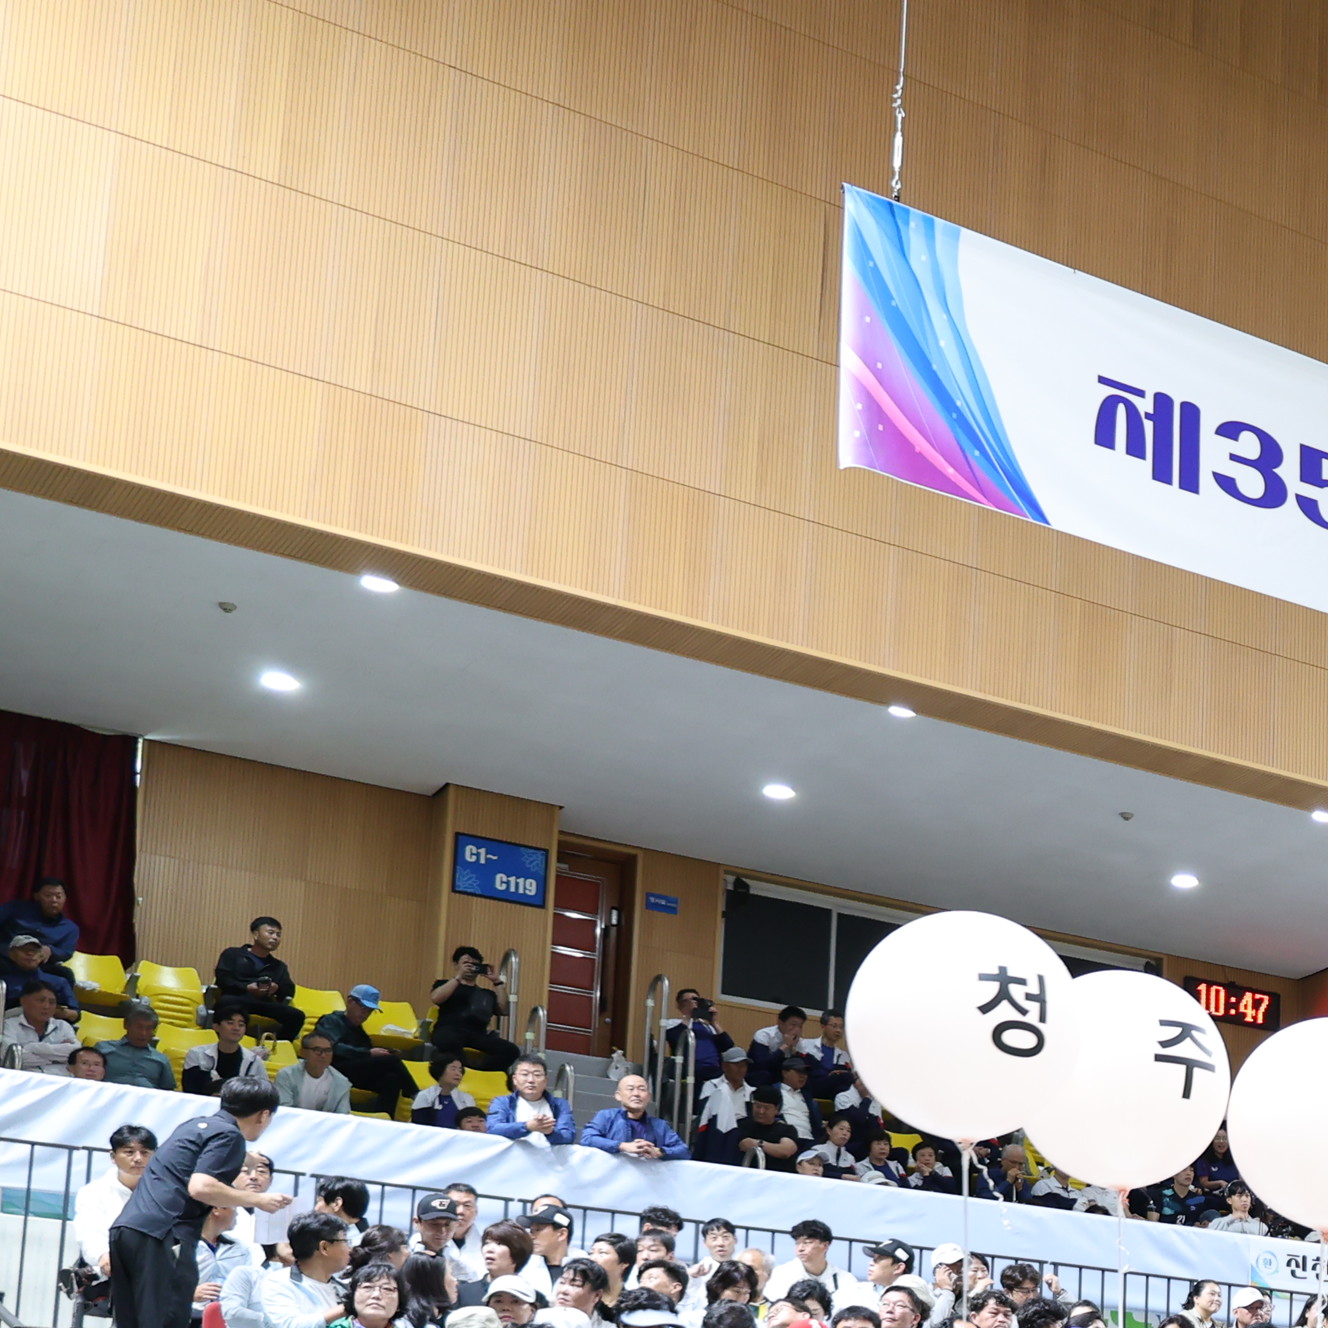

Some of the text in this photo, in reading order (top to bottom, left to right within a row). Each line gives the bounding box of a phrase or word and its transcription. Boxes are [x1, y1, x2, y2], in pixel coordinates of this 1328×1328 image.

[464, 844, 498, 864] C1~
[495, 873, 537, 896] C119
[976, 964, 1047, 1059] 청
[1197, 982, 1270, 1024] 10:47
[1153, 1018, 1216, 1100] 주
